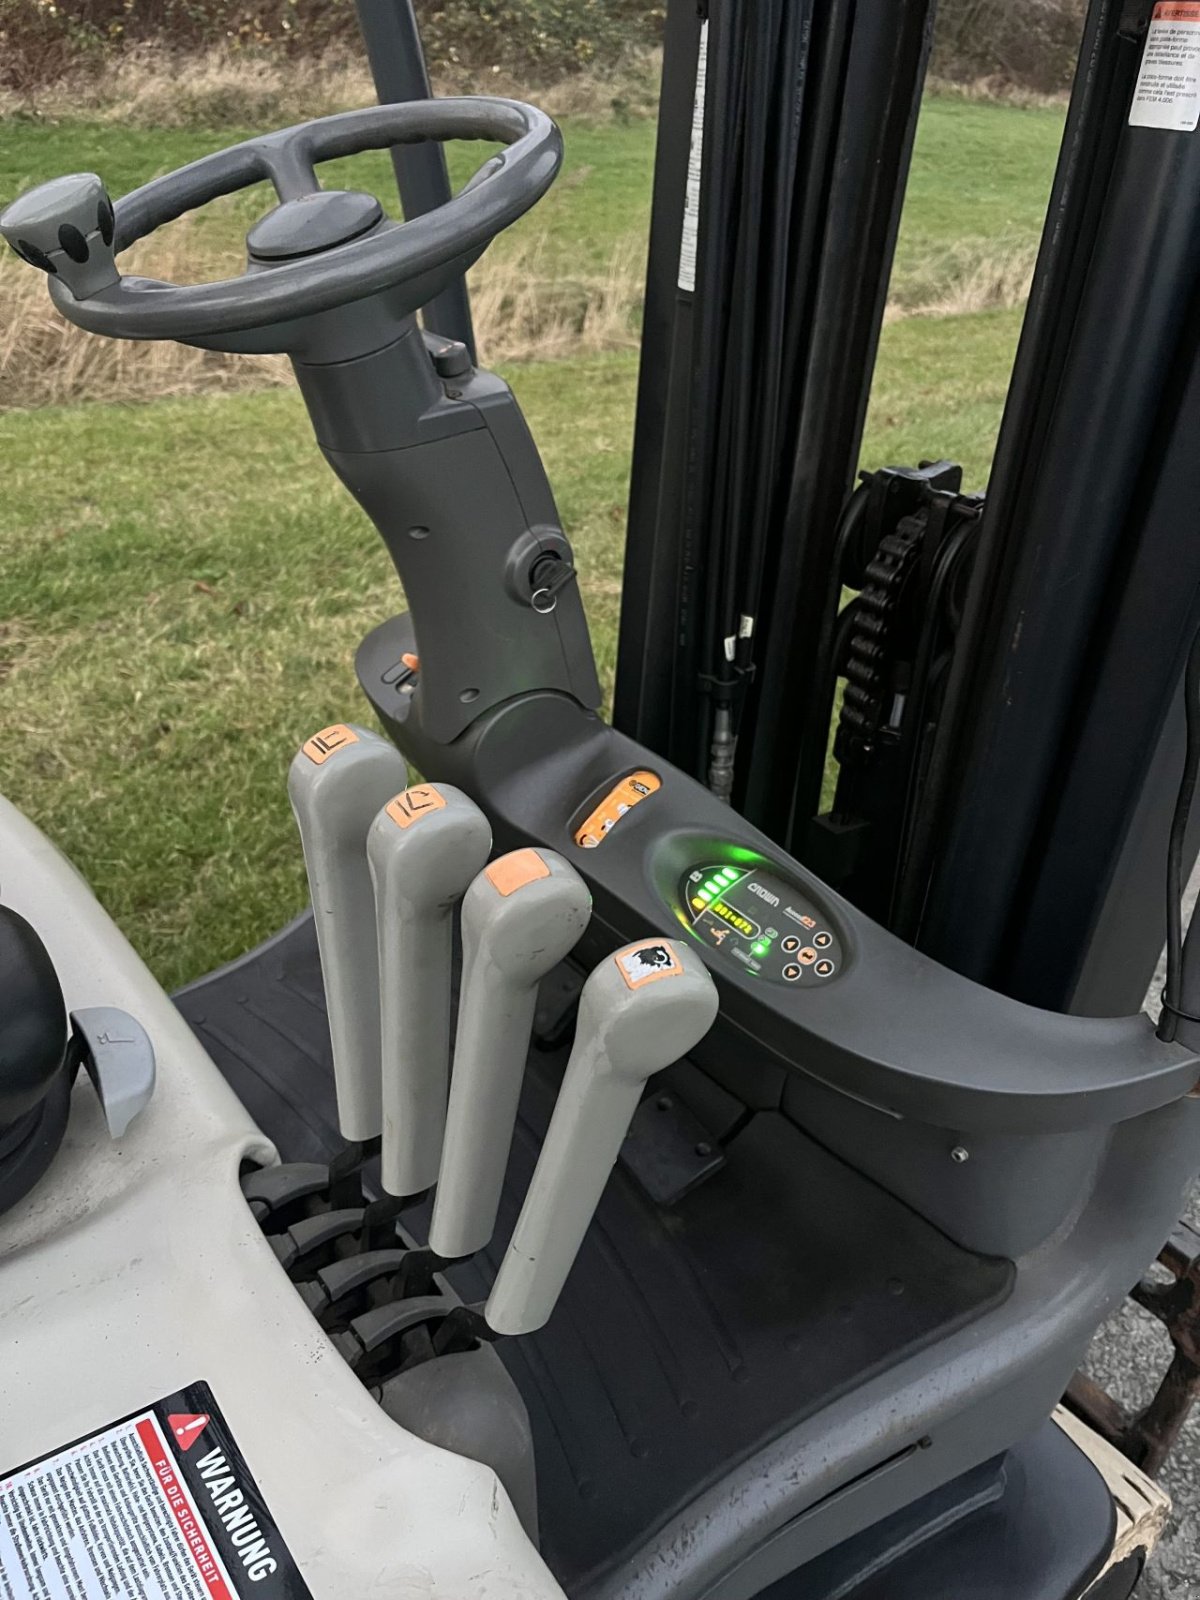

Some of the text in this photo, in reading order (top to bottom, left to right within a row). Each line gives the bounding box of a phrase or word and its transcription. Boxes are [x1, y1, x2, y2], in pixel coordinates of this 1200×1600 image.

[155, 1459, 174, 1484] FÜR
[167, 1486, 184, 1506] DIE
[177, 1508, 219, 1583] SICHERHEIT
[195, 1446, 278, 1582] WARNUNG
